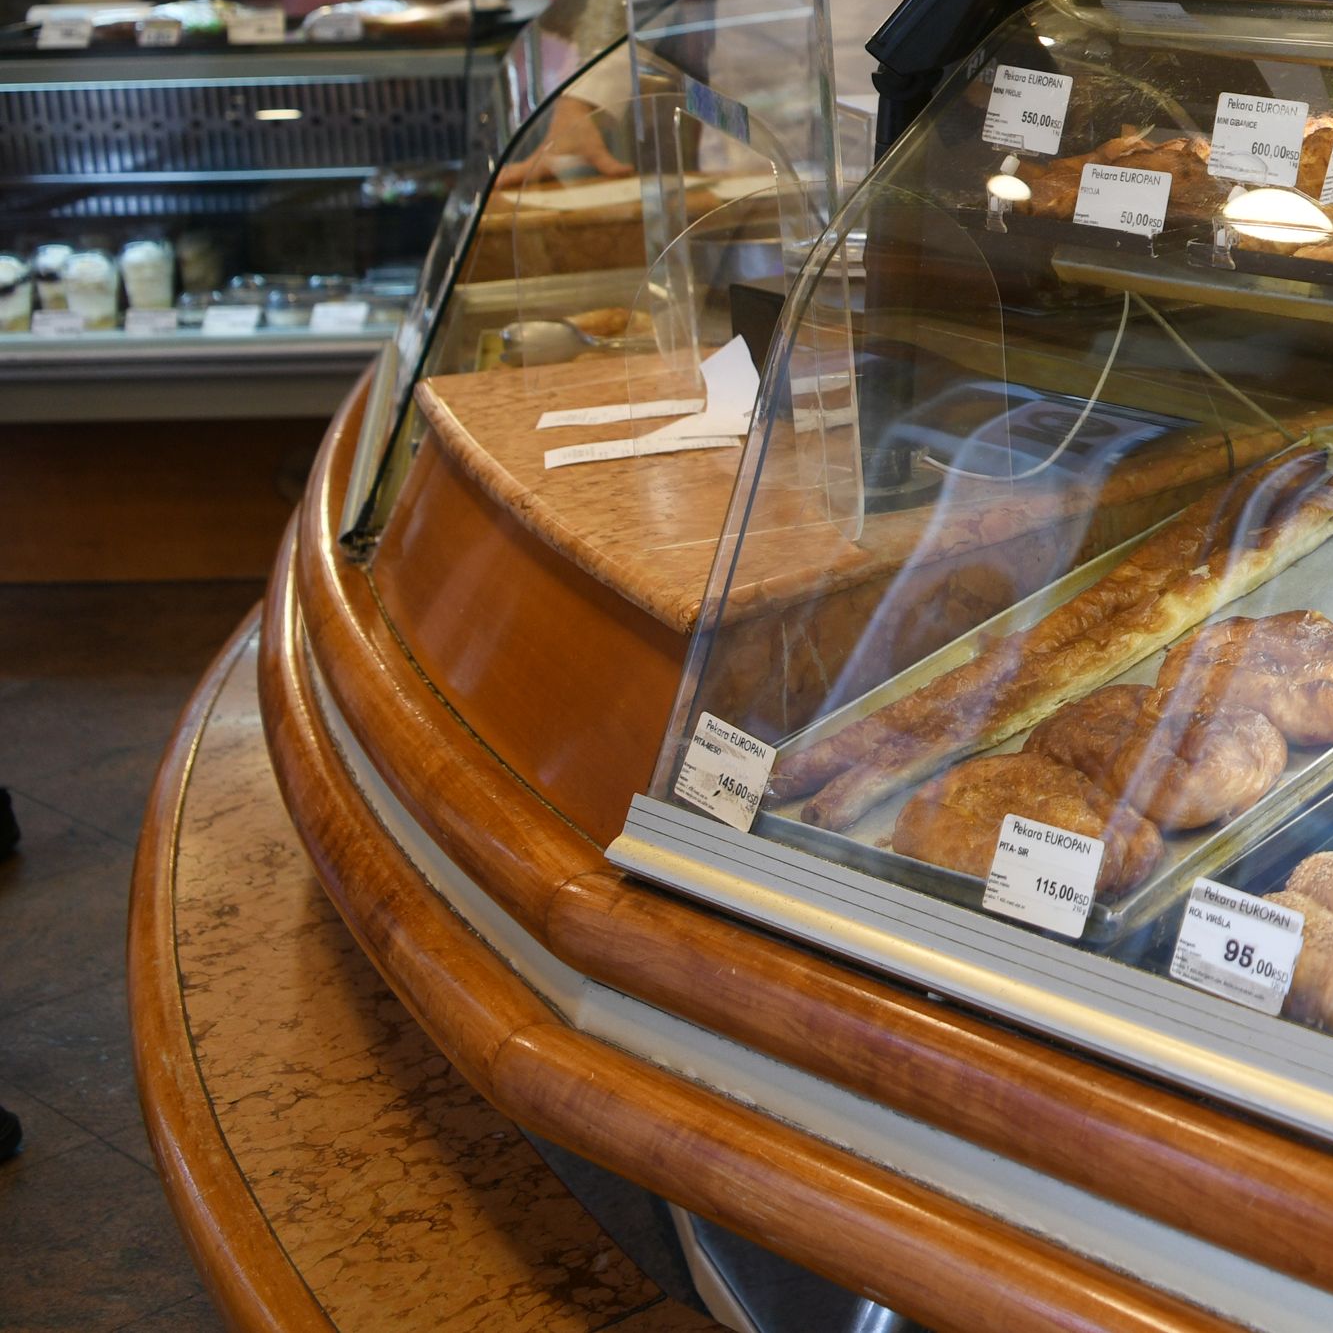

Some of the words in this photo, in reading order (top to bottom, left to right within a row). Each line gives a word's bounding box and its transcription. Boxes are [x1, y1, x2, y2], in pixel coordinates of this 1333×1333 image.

[1004, 70, 1026, 82] Pekara
[1028, 75, 1063, 89] EUROPAN
[994, 87, 1004, 95] MINI
[1228, 98, 1253, 112] Pekara
[1256, 102, 1297, 116] EUROPAN
[1217, 117, 1229, 125] MINI
[1092, 169, 1117, 182] Pekara
[1120, 171, 1161, 186] EUROPAN
[706, 719, 729, 740] Pekara
[730, 733, 766, 759] EUROPAN
[1013, 821, 1042, 840] Pekara
[1045, 831, 1091, 854] EUROPAN
[1018, 846, 1029, 857] SIR
[1036, 877, 1074, 901] 115,00
[1204, 886, 1236, 908] Pekara
[1240, 899, 1291, 928] EUROPAN
[1189, 907, 1202, 919] ROL
[1206, 913, 1230, 928] VIRŠLA
